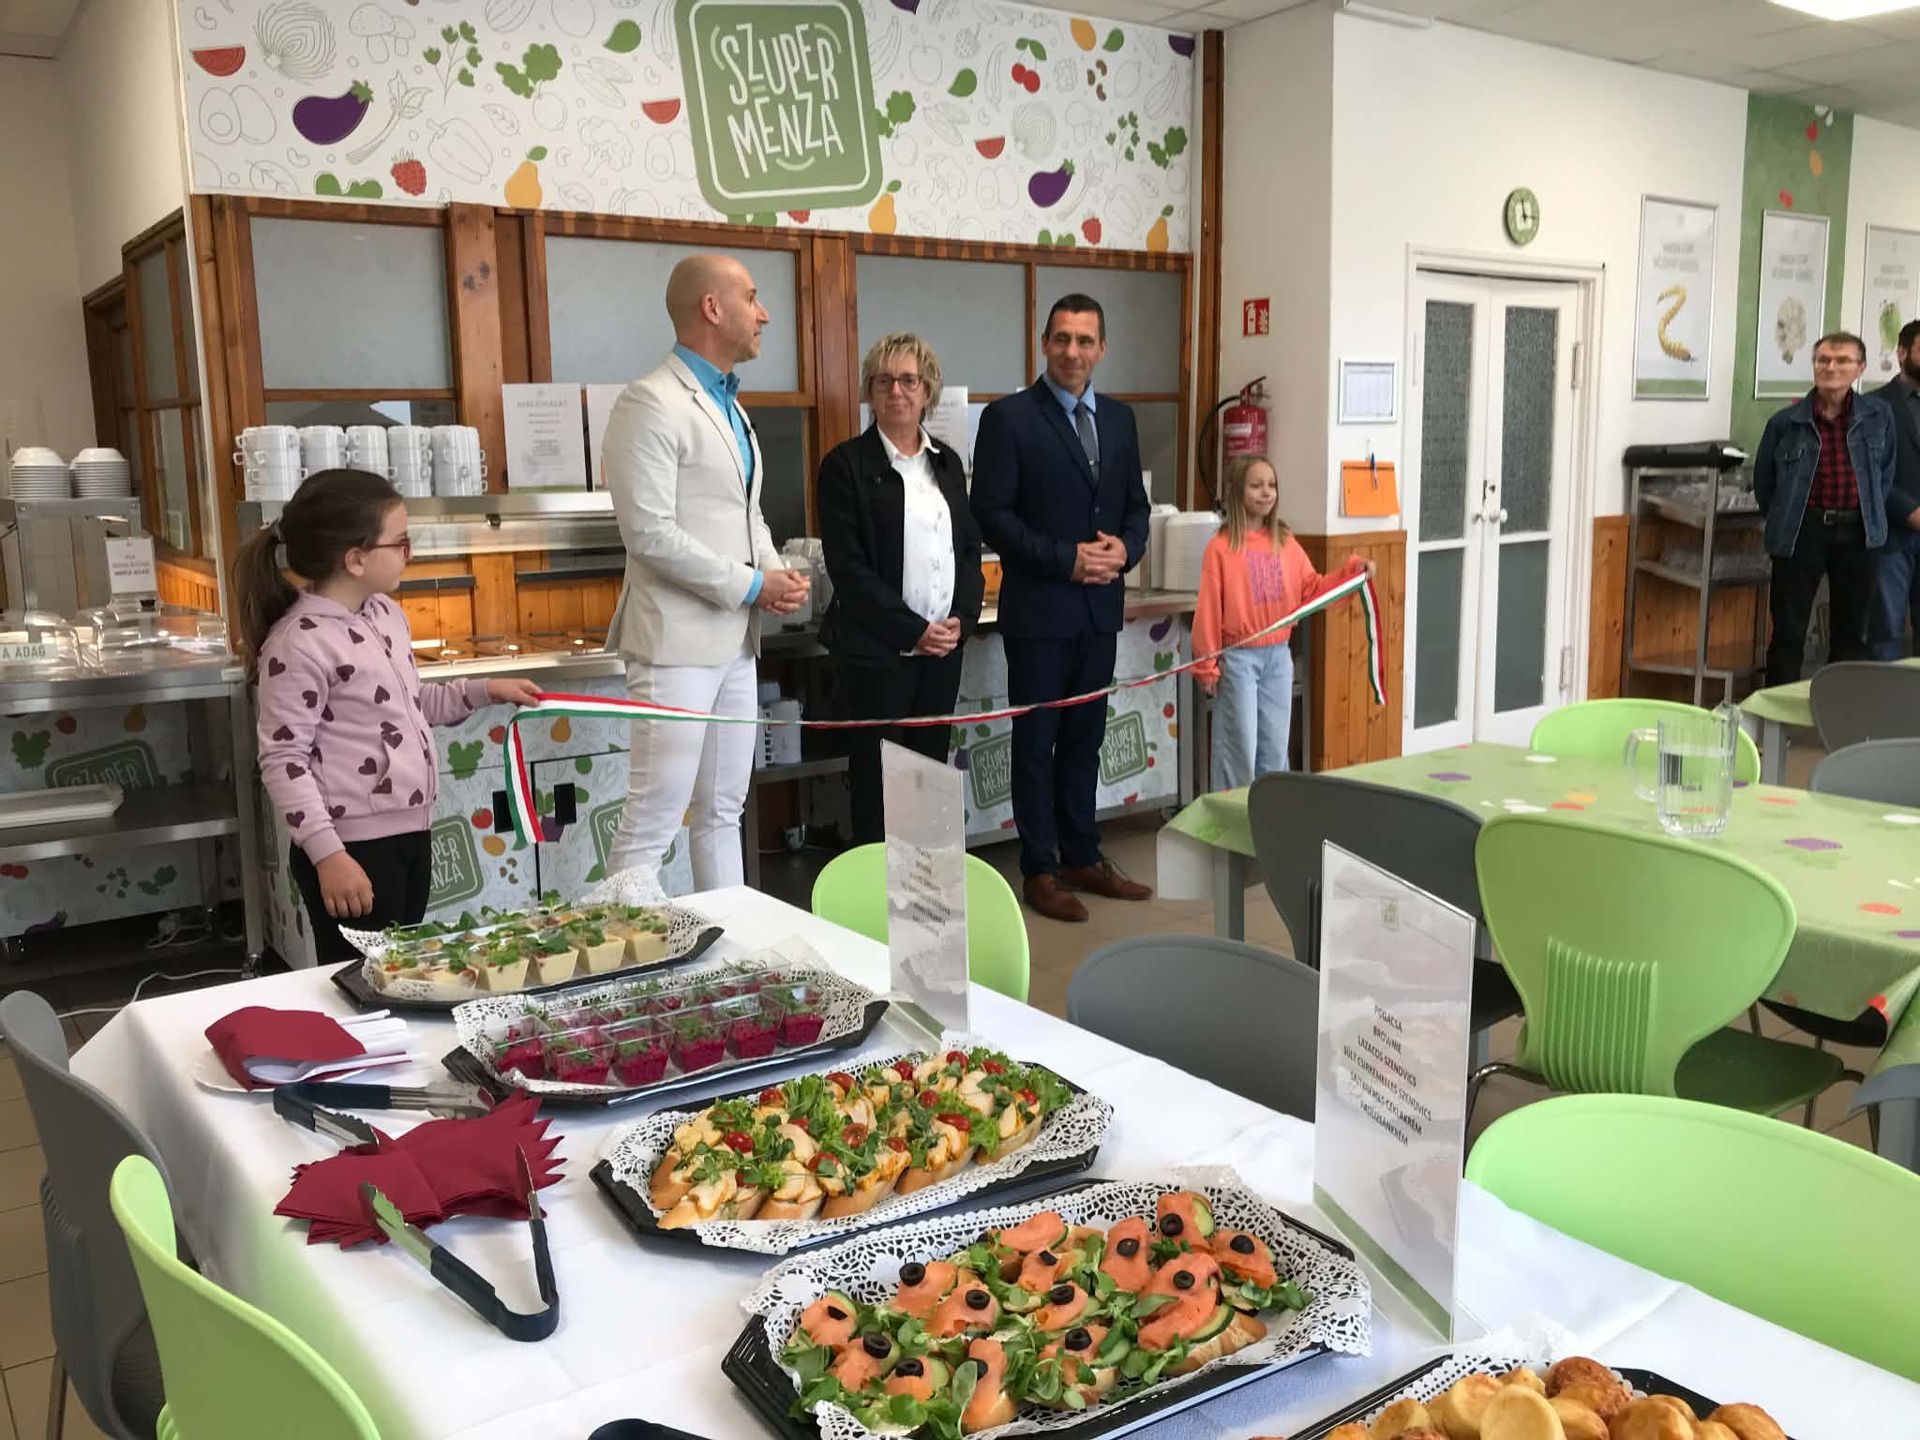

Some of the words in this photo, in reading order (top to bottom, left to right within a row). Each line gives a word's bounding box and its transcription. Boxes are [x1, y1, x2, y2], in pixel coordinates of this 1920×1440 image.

[720, 23, 840, 106] SZUPER
[727, 91, 845, 179] MENZA
[981, 764, 1011, 799] MENZ
[1357, 1034, 1383, 1062] LAZACOS
[1372, 1025, 1402, 1055] BROWNIE
